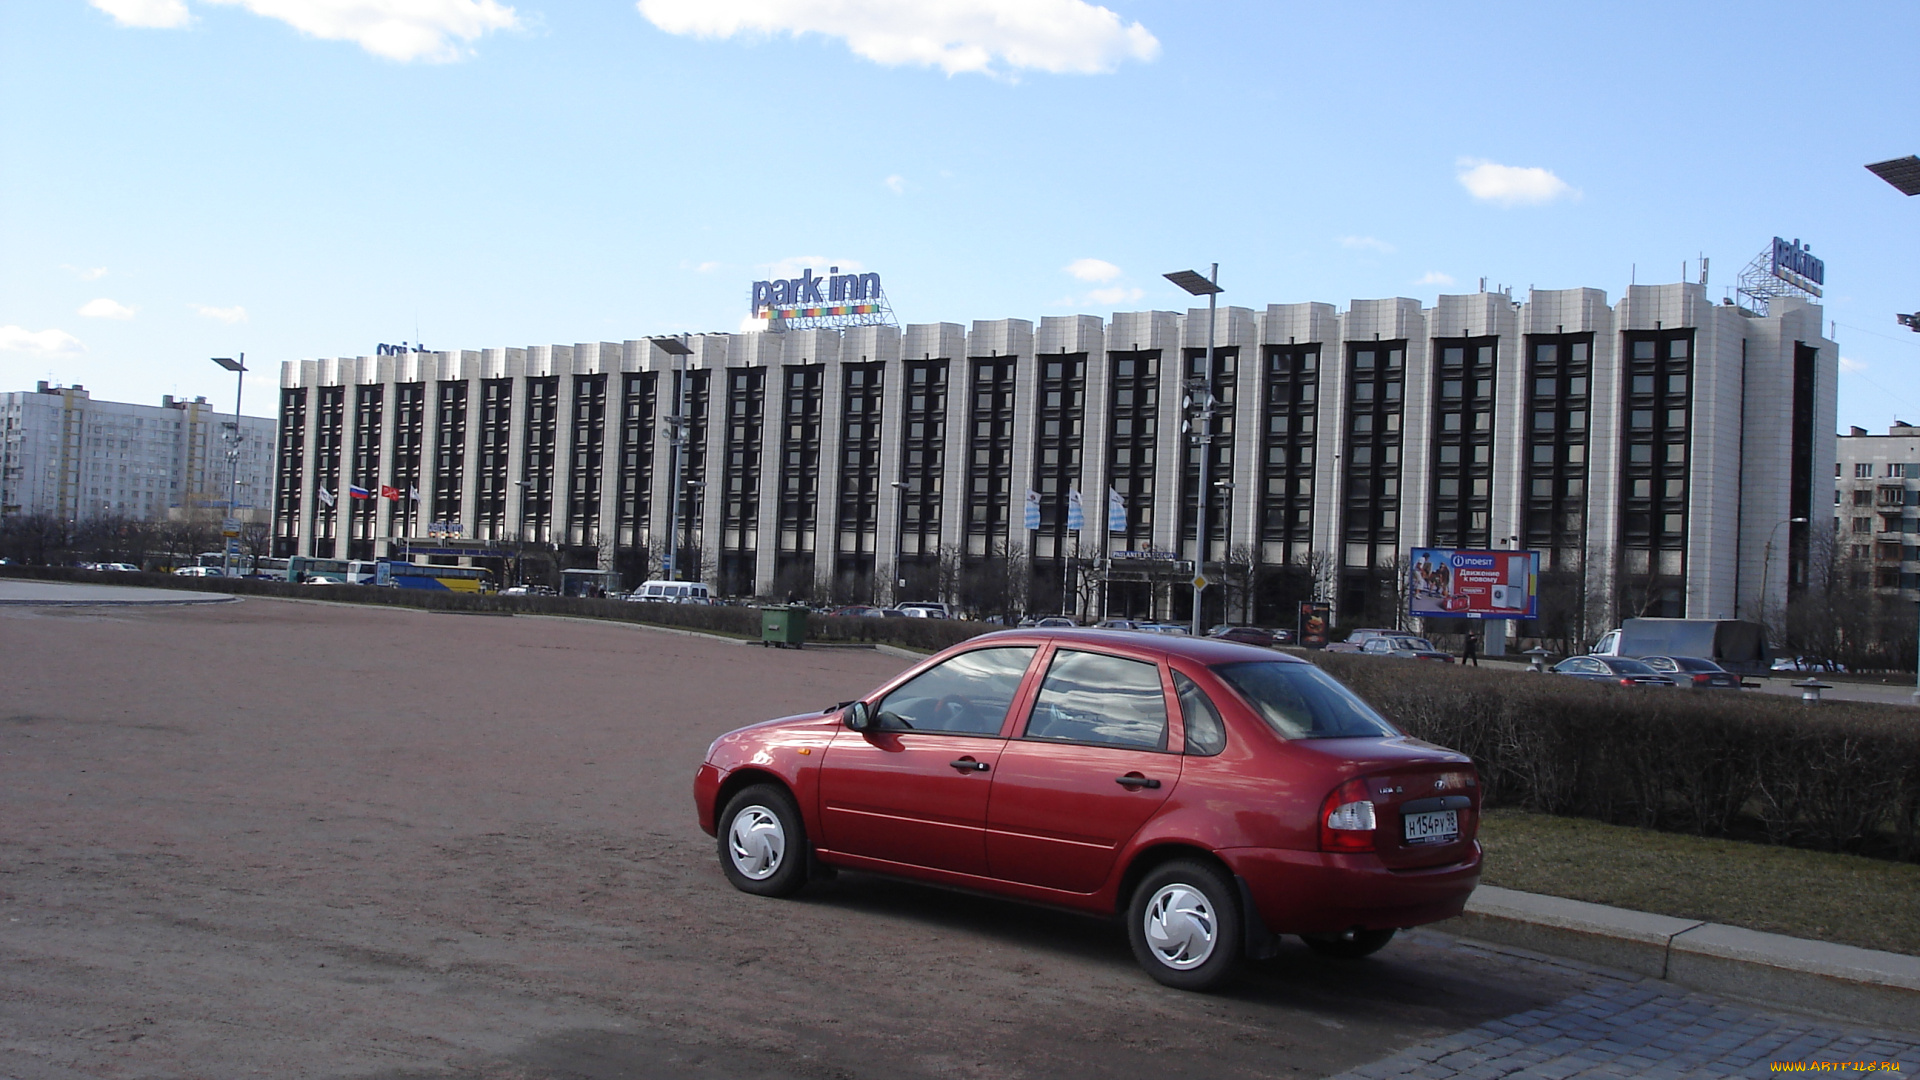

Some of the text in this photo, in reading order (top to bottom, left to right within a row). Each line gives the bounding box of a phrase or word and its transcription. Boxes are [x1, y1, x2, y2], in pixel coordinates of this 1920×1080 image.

[1804, 244, 1824, 285] inn
[752, 266, 881, 319] park inn
[1459, 569, 1500, 577] Движение
